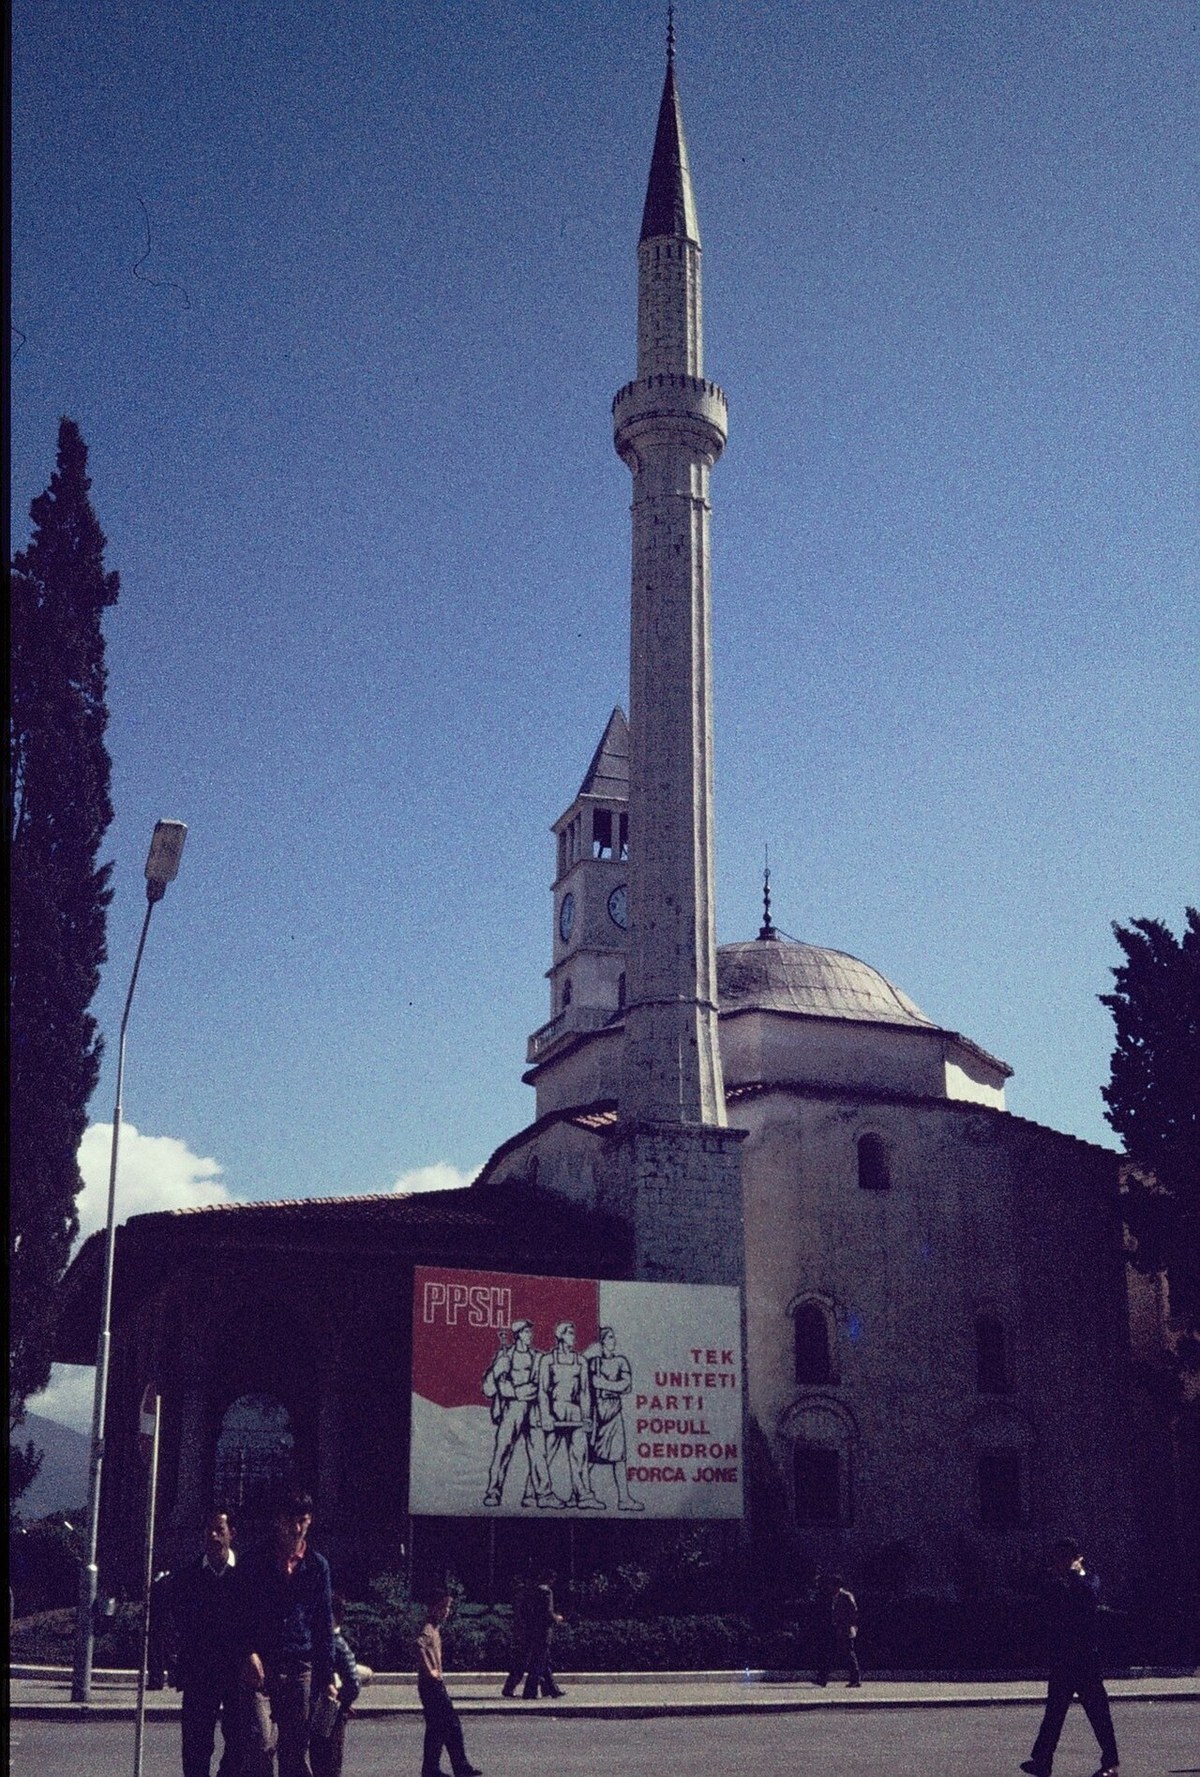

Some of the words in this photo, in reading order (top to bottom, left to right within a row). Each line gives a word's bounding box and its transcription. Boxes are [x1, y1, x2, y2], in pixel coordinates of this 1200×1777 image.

[423, 1282, 512, 1329] PPSH
[690, 1349, 734, 1365] TEK
[655, 1371, 736, 1388] UNITETI
[636, 1394, 704, 1411] PARTI
[636, 1418, 711, 1435] POPULL
[637, 1442, 738, 1459] QENDRON
[626, 1466, 687, 1482] FORCA
[691, 1466, 738, 1483] JONE
